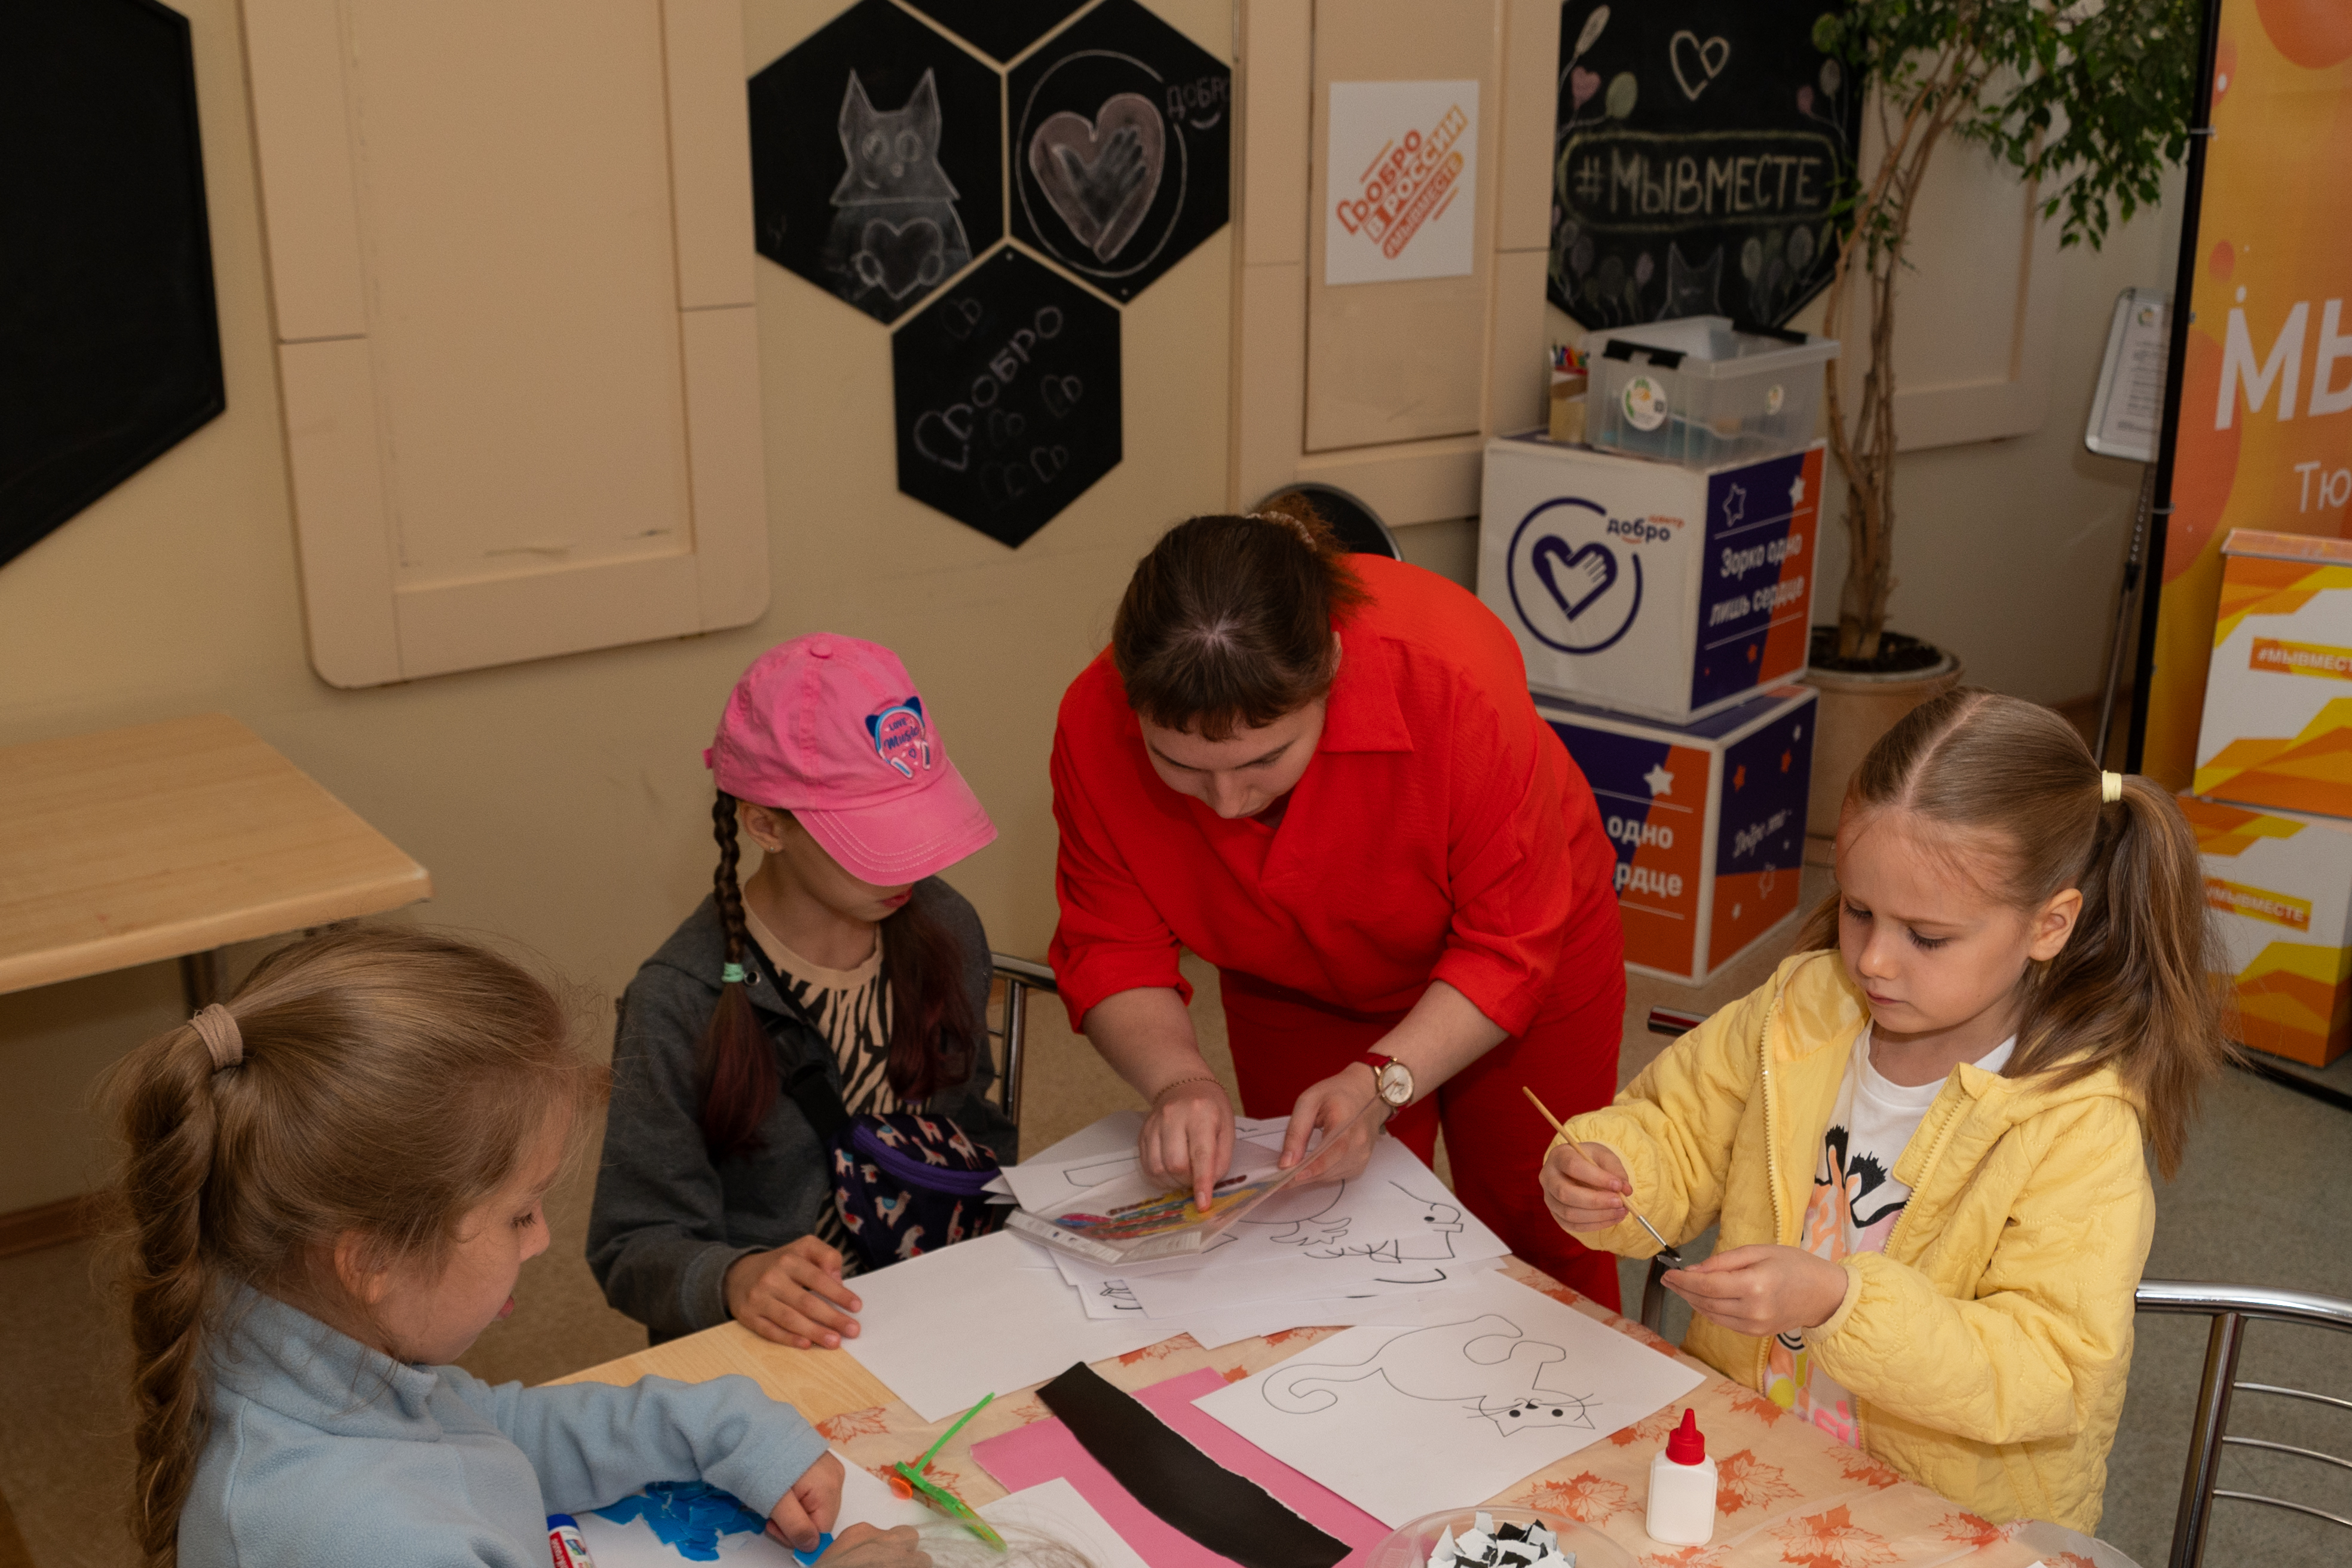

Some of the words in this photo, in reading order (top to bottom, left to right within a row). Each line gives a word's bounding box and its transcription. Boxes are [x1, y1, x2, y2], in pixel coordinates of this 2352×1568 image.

[1383, 108, 1465, 218] РОССИИ
[1573, 148, 1821, 216] #МЫВМЕСТЕ
[1607, 517, 1671, 543] добро
[1720, 546, 1765, 581] Зорко
[1709, 595, 1750, 627] лишь
[1607, 815, 1673, 849] одно
[1615, 862, 1683, 899] рдце
